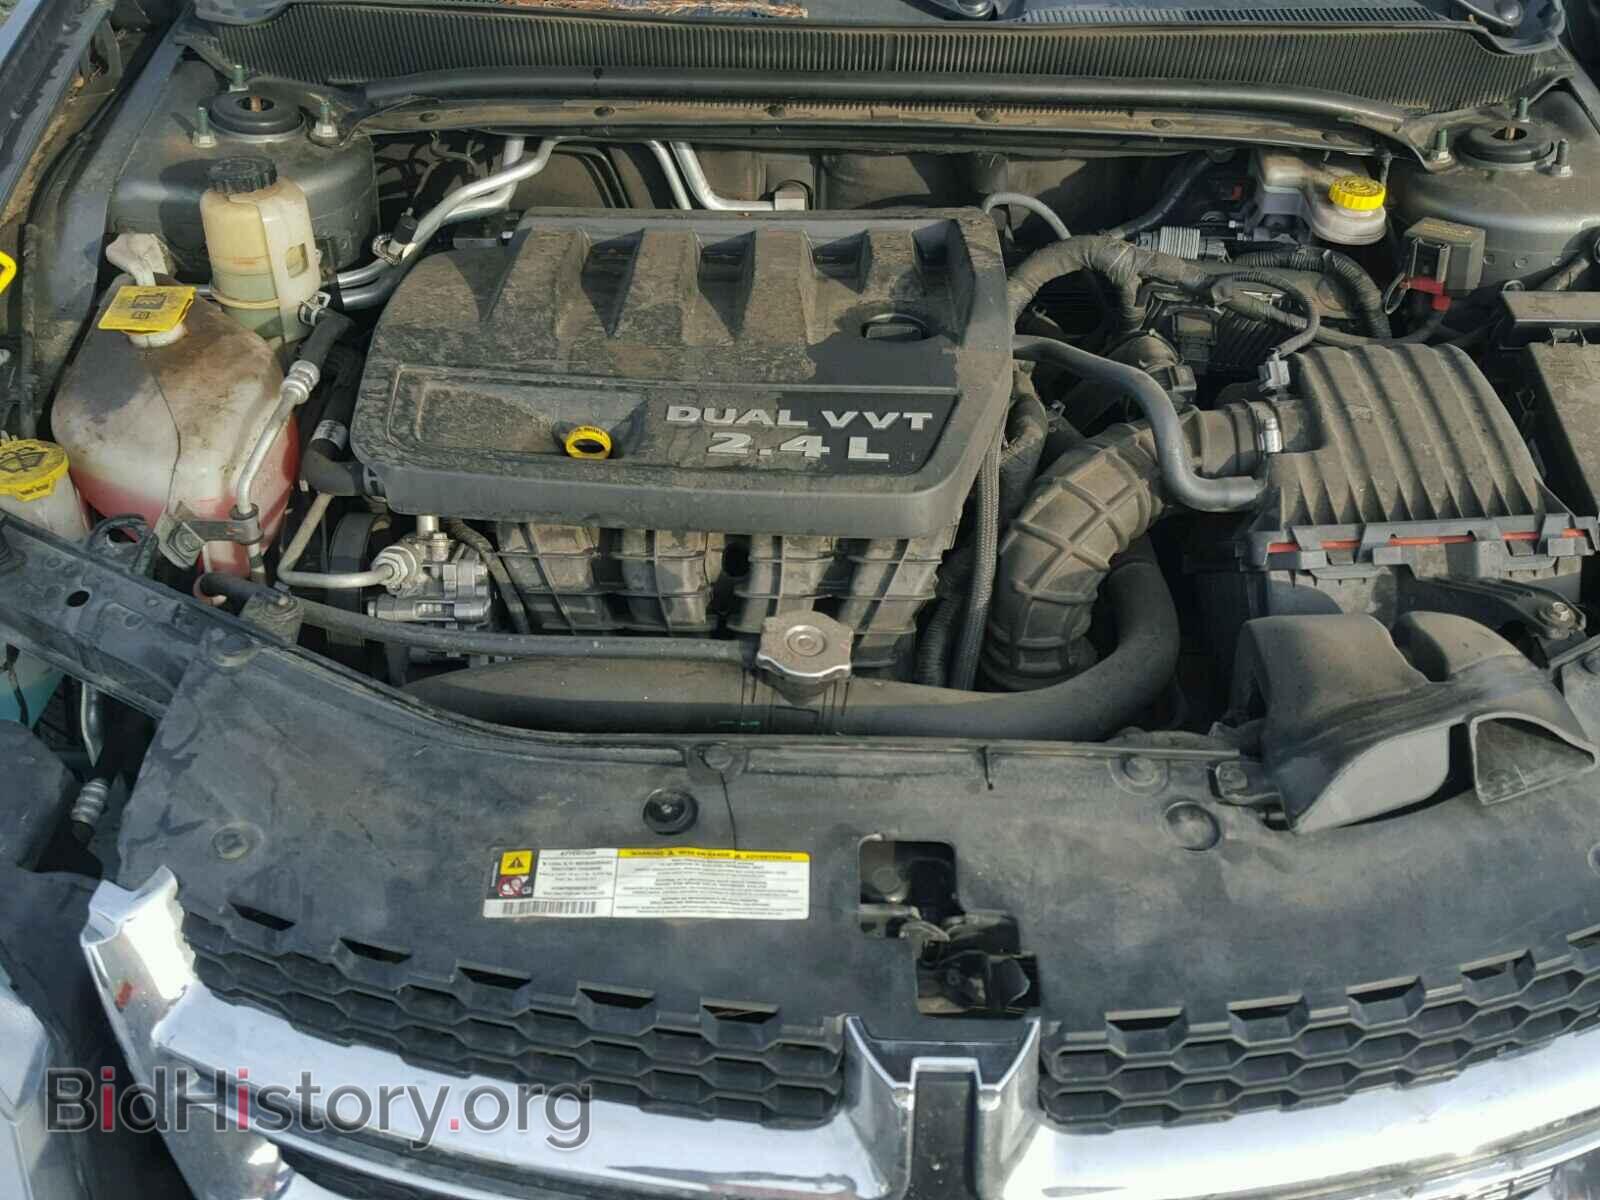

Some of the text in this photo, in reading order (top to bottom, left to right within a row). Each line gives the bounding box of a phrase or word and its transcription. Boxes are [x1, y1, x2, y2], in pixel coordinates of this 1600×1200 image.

[666, 404, 933, 431] DUAL VVT
[706, 432, 890, 461] 2.4 L
